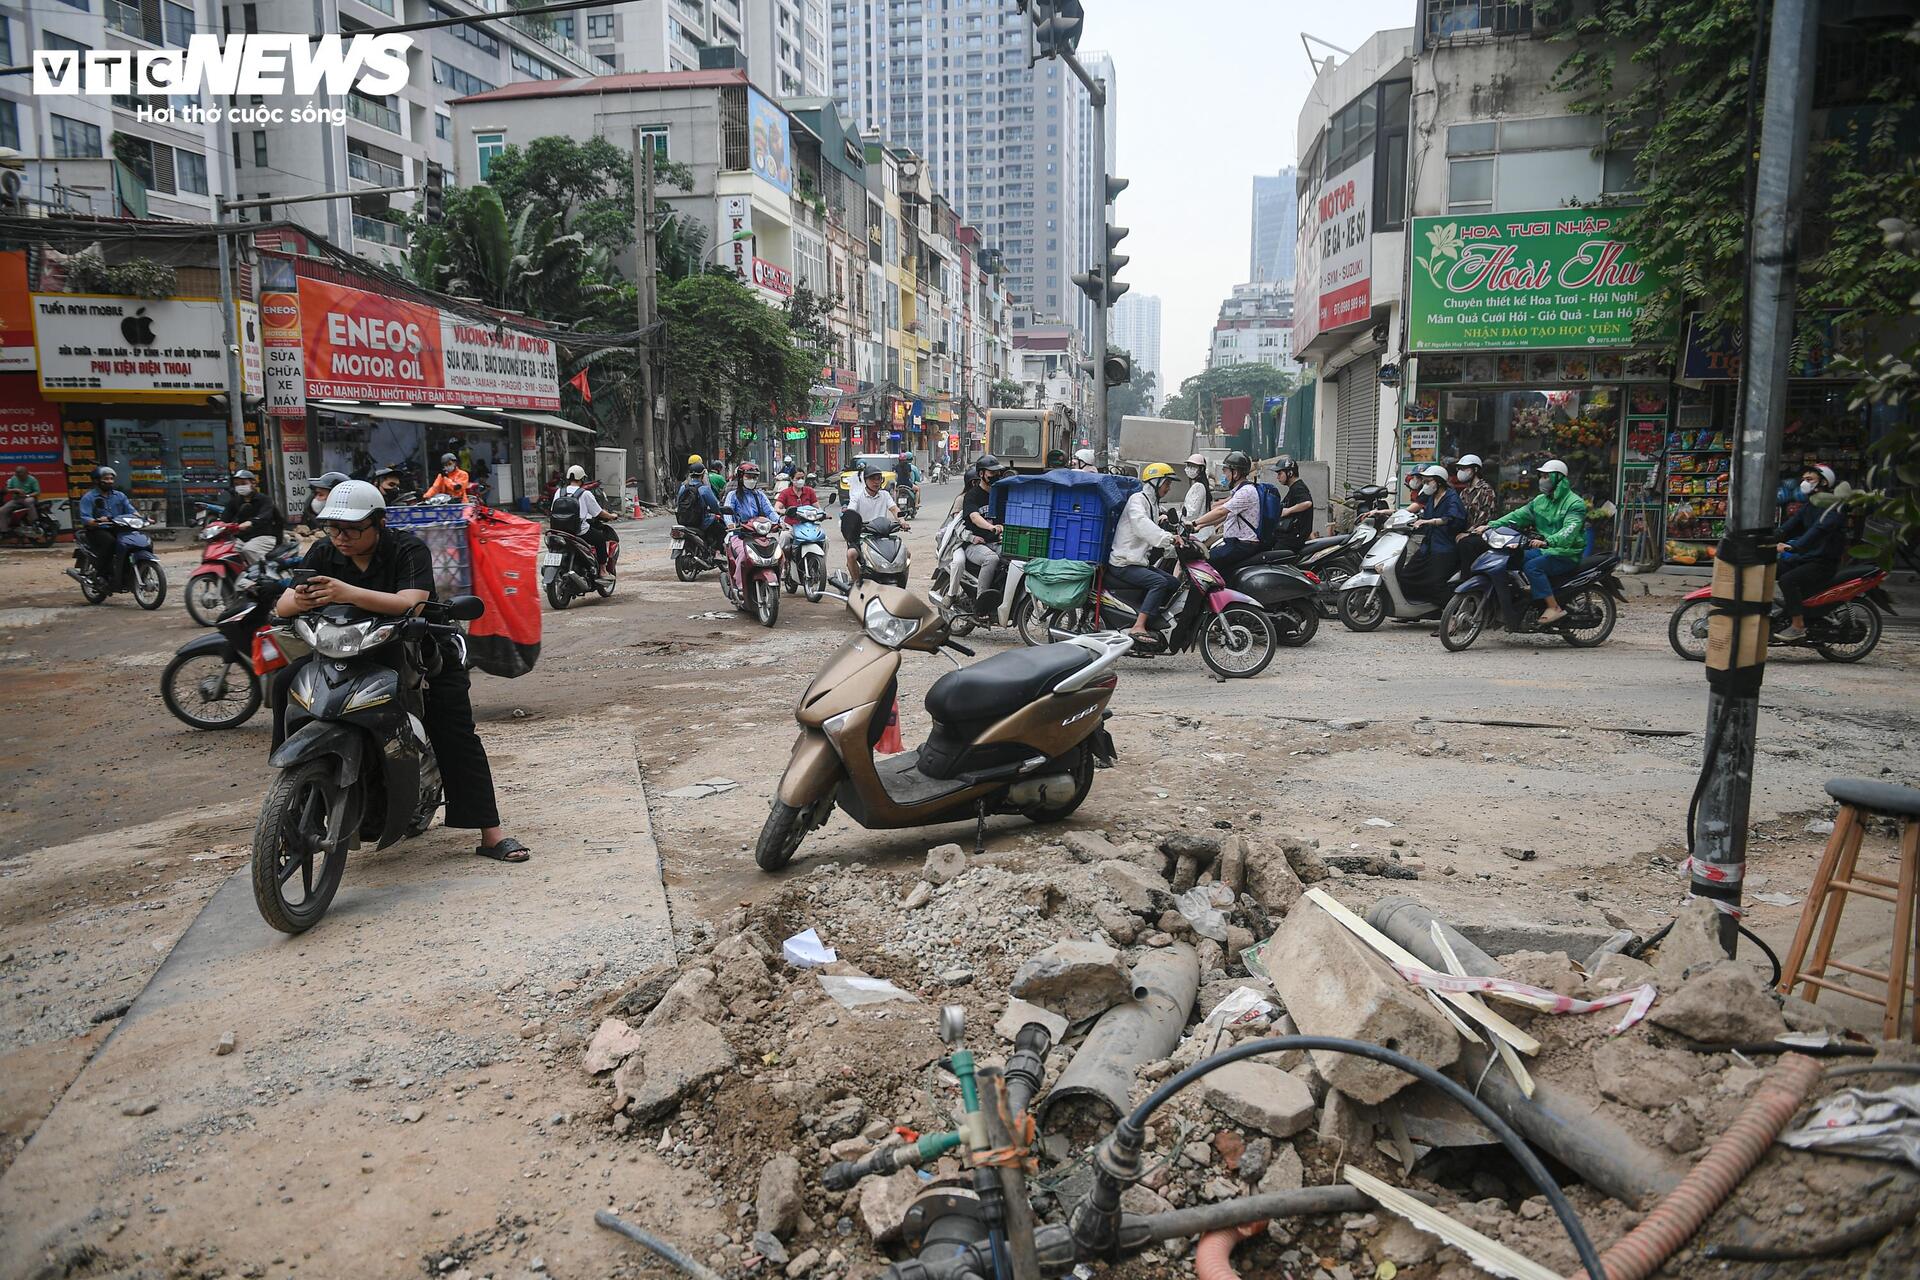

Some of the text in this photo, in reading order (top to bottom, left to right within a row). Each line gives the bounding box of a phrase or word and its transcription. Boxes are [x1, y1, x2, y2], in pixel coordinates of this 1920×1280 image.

[1319, 180, 1356, 224] MOTOR
[1461, 226, 1500, 240] HOA
[1508, 222, 1550, 238] TƯƠI
[1556, 217, 1610, 237] NHẬP
[732, 218, 747, 280] KREA
[1327, 258, 1363, 286] SYM SUZUKI
[1447, 240, 1645, 292] Hoài Thu
[1444, 298, 1483, 310] Chuyên
[1486, 295, 1512, 307] thiết
[1514, 294, 1527, 306] kế
[1530, 295, 1550, 305] Hoa
[1554, 294, 1578, 304] Tươi
[1590, 293, 1608, 304] Hội
[1427, 314, 1454, 324] Mâm
[1456, 312, 1478, 324] Quả
[1482, 311, 1506, 322] Cưới
[1509, 311, 1527, 322] Hỏi
[1538, 310, 1556, 321] Giỏ
[1560, 309, 1582, 321] Quả
[1593, 308, 1613, 319] Lan
[327, 312, 421, 354] ENEOS
[1464, 322, 1620, 339] NHẬN ĐÀO TẠO HỌC VIÊN
[518, 335, 550, 356] MOTOR
[270, 349, 295, 361] SỬA
[447, 347, 460, 370] SỬA
[520, 359, 528, 377] XE
[528, 360, 537, 378] GA
[540, 362, 548, 379] XE
[91, 360, 192, 377] PHỤ KIỆN ĐIỆN THOẠI
[267, 365, 301, 377] CHỮA
[332, 353, 424, 380] MOTOR OIL
[1706, 351, 1742, 378] Tig
[278, 380, 293, 390] XE
[450, 375, 471, 386] HONDA
[475, 377, 497, 387] YAMAHA
[309, 382, 331, 396] SỨC
[333, 385, 360, 399] MẠNH
[361, 384, 379, 399] DẦU
[381, 387, 404, 400] NHỚT
[406, 389, 427, 401] NHẬT
[274, 396, 298, 406] MÁY
[11, 422, 29, 432] CƠ
[32, 422, 54, 434] HỘI
[820, 429, 840, 438] VÀNG
[11, 436, 29, 445] AN
[32, 434, 58, 445] TÂM
[290, 453, 303, 465] SỬA
[288, 468, 306, 480] CHỮA
[292, 484, 305, 496] BẢO
